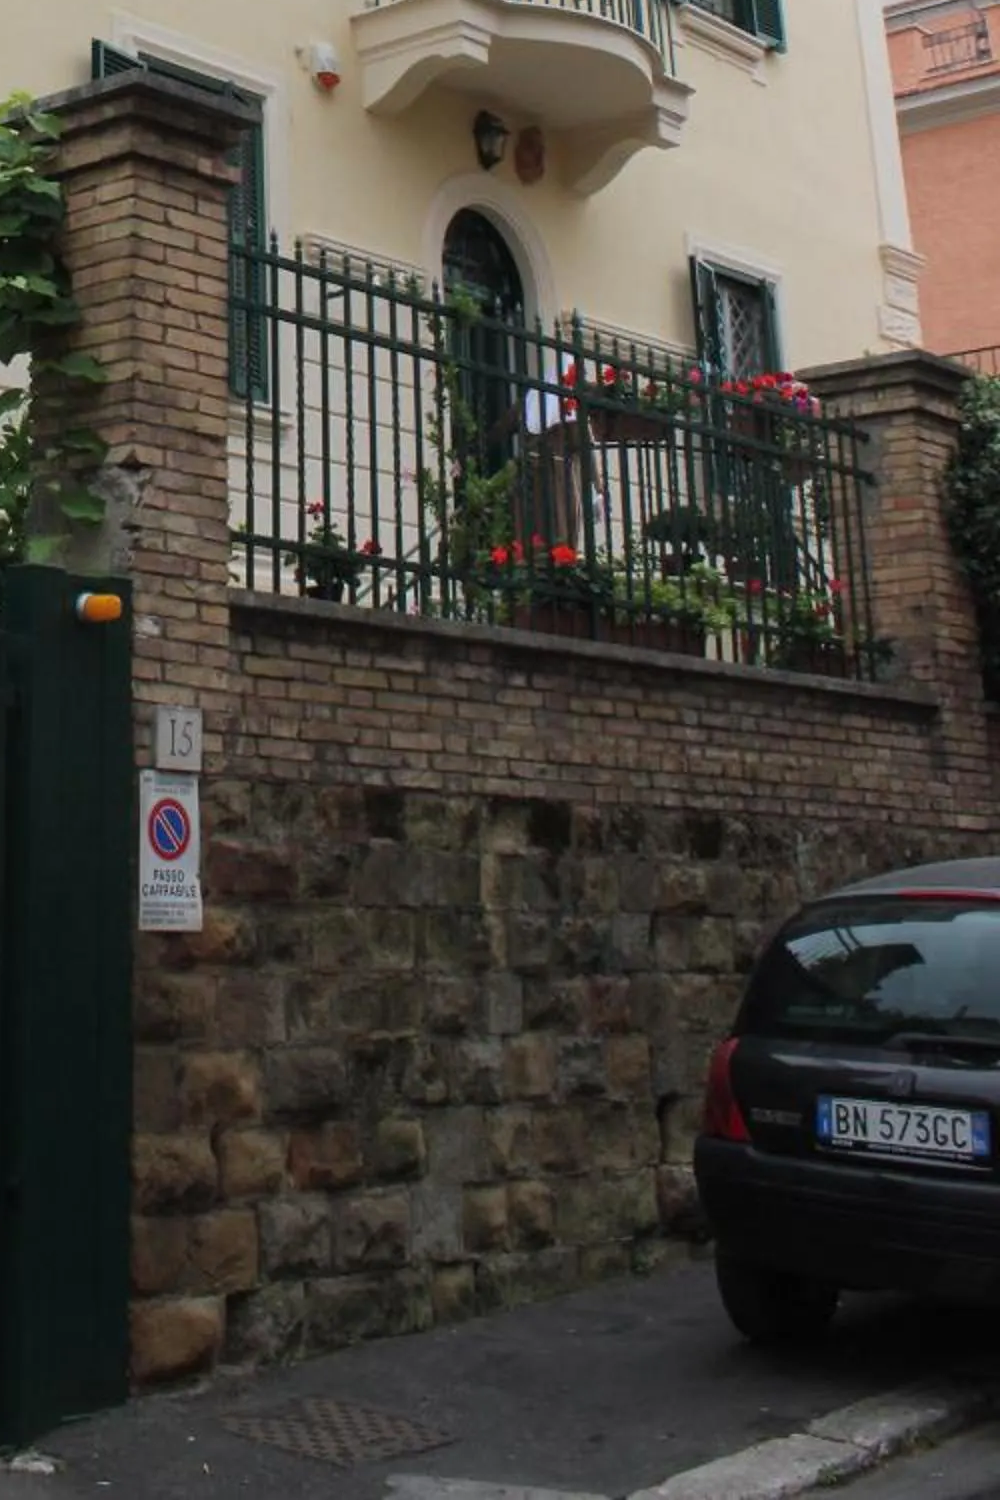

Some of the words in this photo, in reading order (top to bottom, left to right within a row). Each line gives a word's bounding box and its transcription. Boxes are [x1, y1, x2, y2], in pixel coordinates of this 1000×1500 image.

[170, 719, 193, 757] 15
[153, 868, 185, 882] PASSO
[142, 884, 198, 898] CARRABILE
[835, 1104, 868, 1137] BN
[879, 1109, 967, 1148] 573GC
